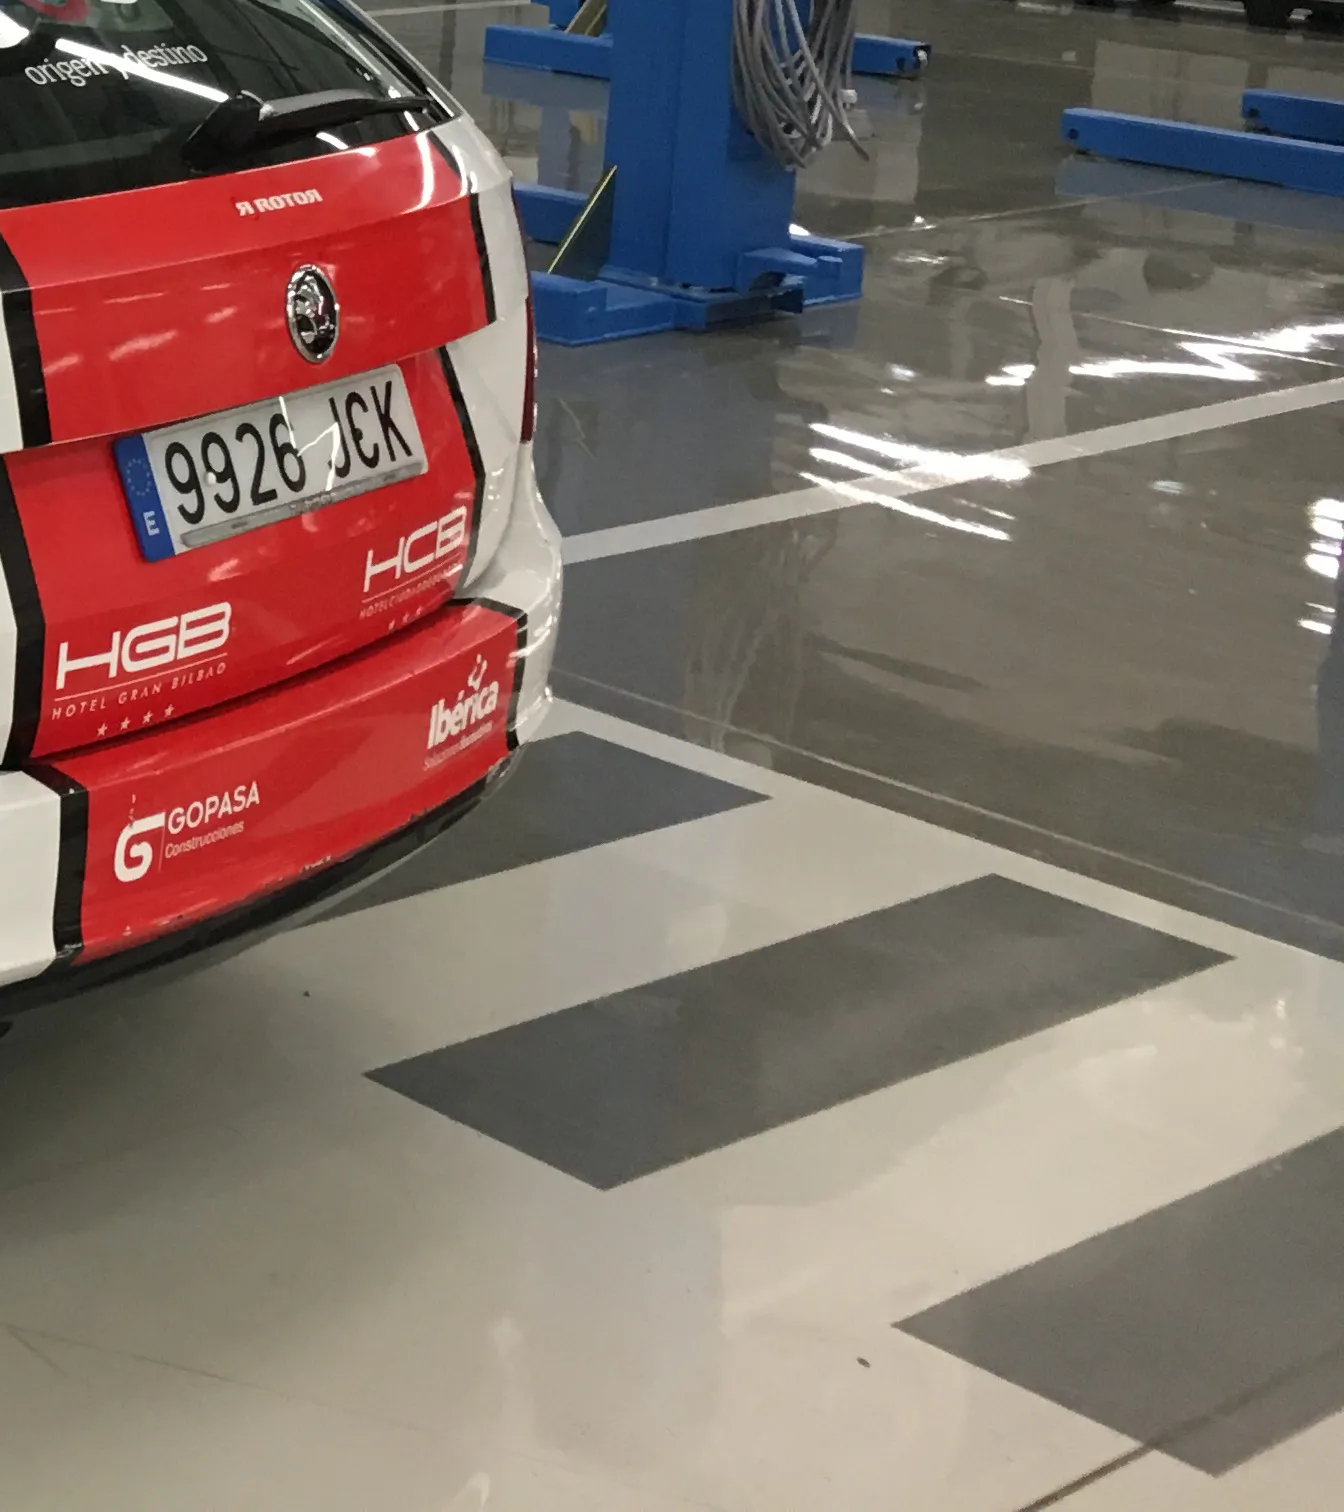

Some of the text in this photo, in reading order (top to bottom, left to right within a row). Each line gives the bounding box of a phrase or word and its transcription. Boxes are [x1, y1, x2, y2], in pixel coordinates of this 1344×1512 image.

[23, 57, 110, 88] origen
[120, 42, 209, 71] destino
[164, 380, 413, 525] 9926 JCK
[142, 509, 161, 537] E
[363, 505, 468, 593] HCB
[55, 601, 232, 690] HGB
[51, 662, 227, 720] HOTEL GRAN BILBAO
[426, 680, 500, 750] Ibérica
[167, 780, 261, 835] GOPASA
[164, 820, 245, 859] Construcciones
